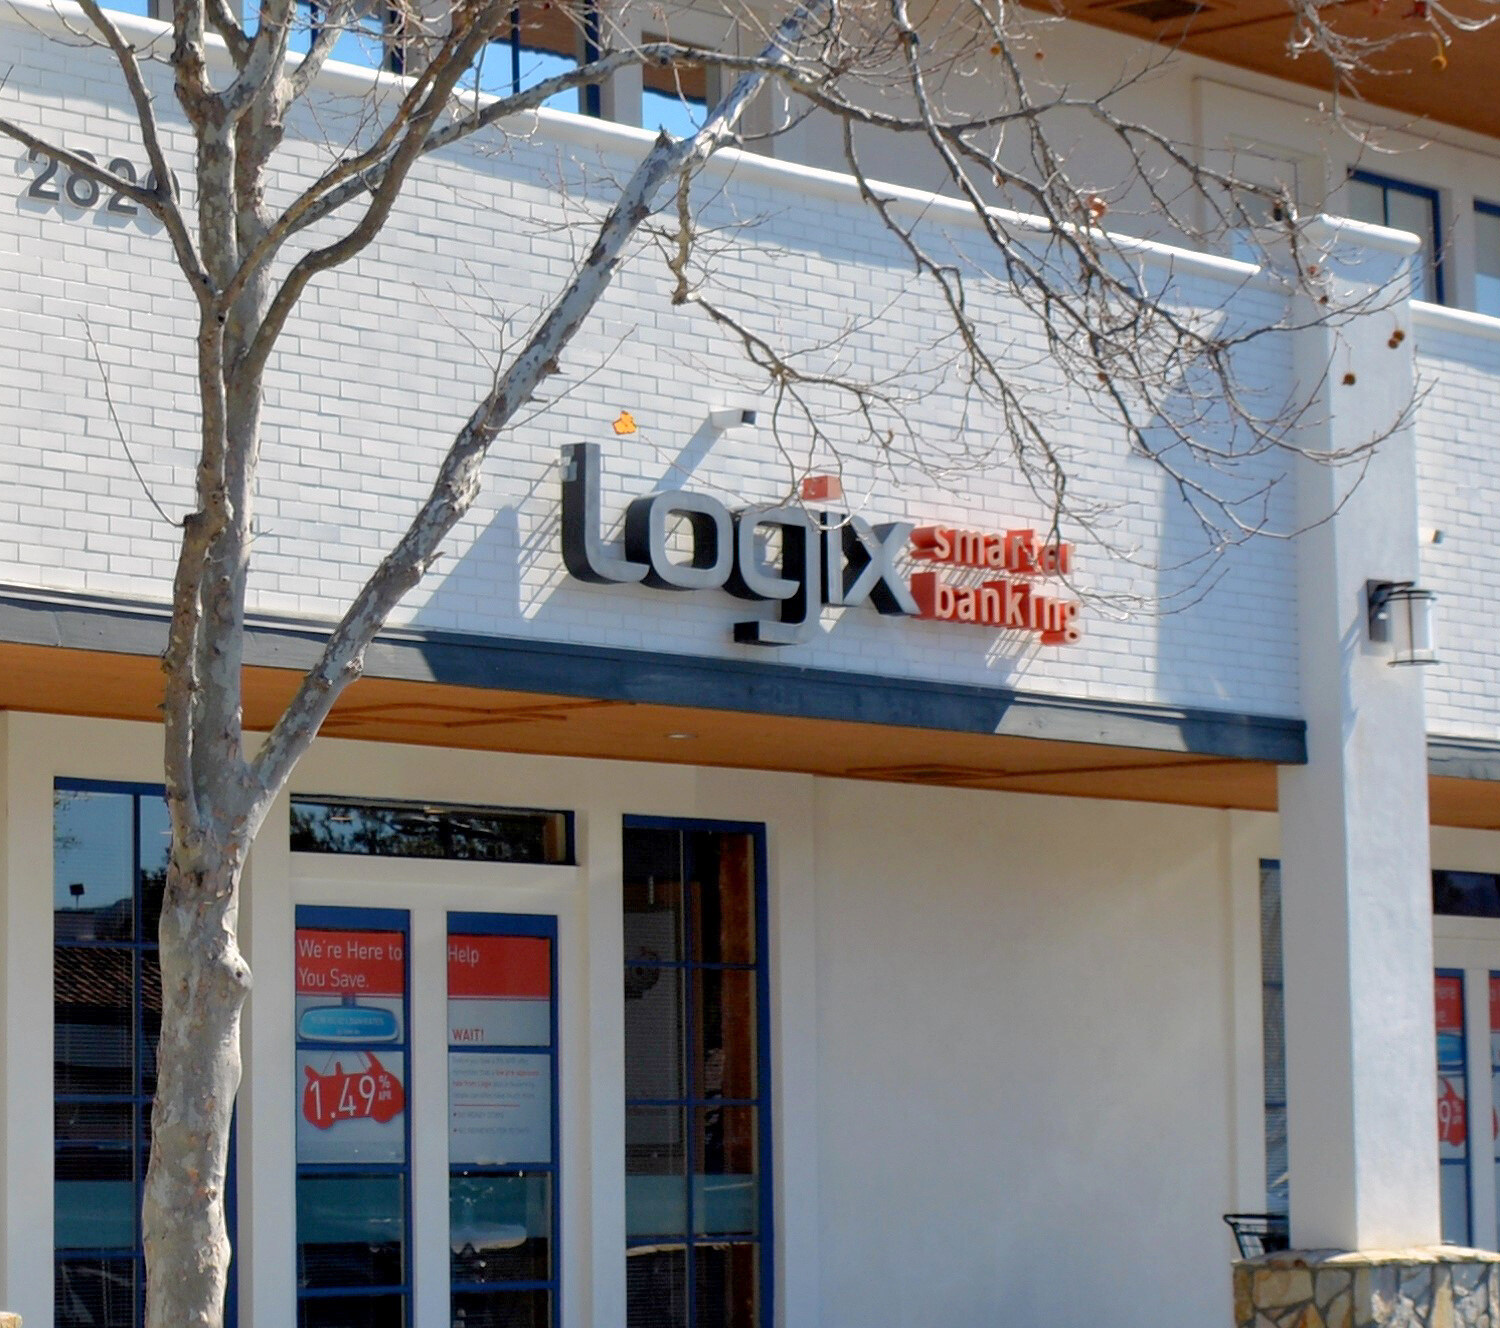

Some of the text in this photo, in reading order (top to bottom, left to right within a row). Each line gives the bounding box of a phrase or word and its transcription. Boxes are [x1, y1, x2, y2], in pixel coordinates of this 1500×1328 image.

[920, 525, 1075, 576] smarter
[920, 574, 1081, 645] banking
[298, 939, 480, 967] We're Here to Help
[298, 968, 370, 989] You Save.
[452, 1028, 484, 1042] WAIT!
[310, 1075, 376, 1120] 1.49
